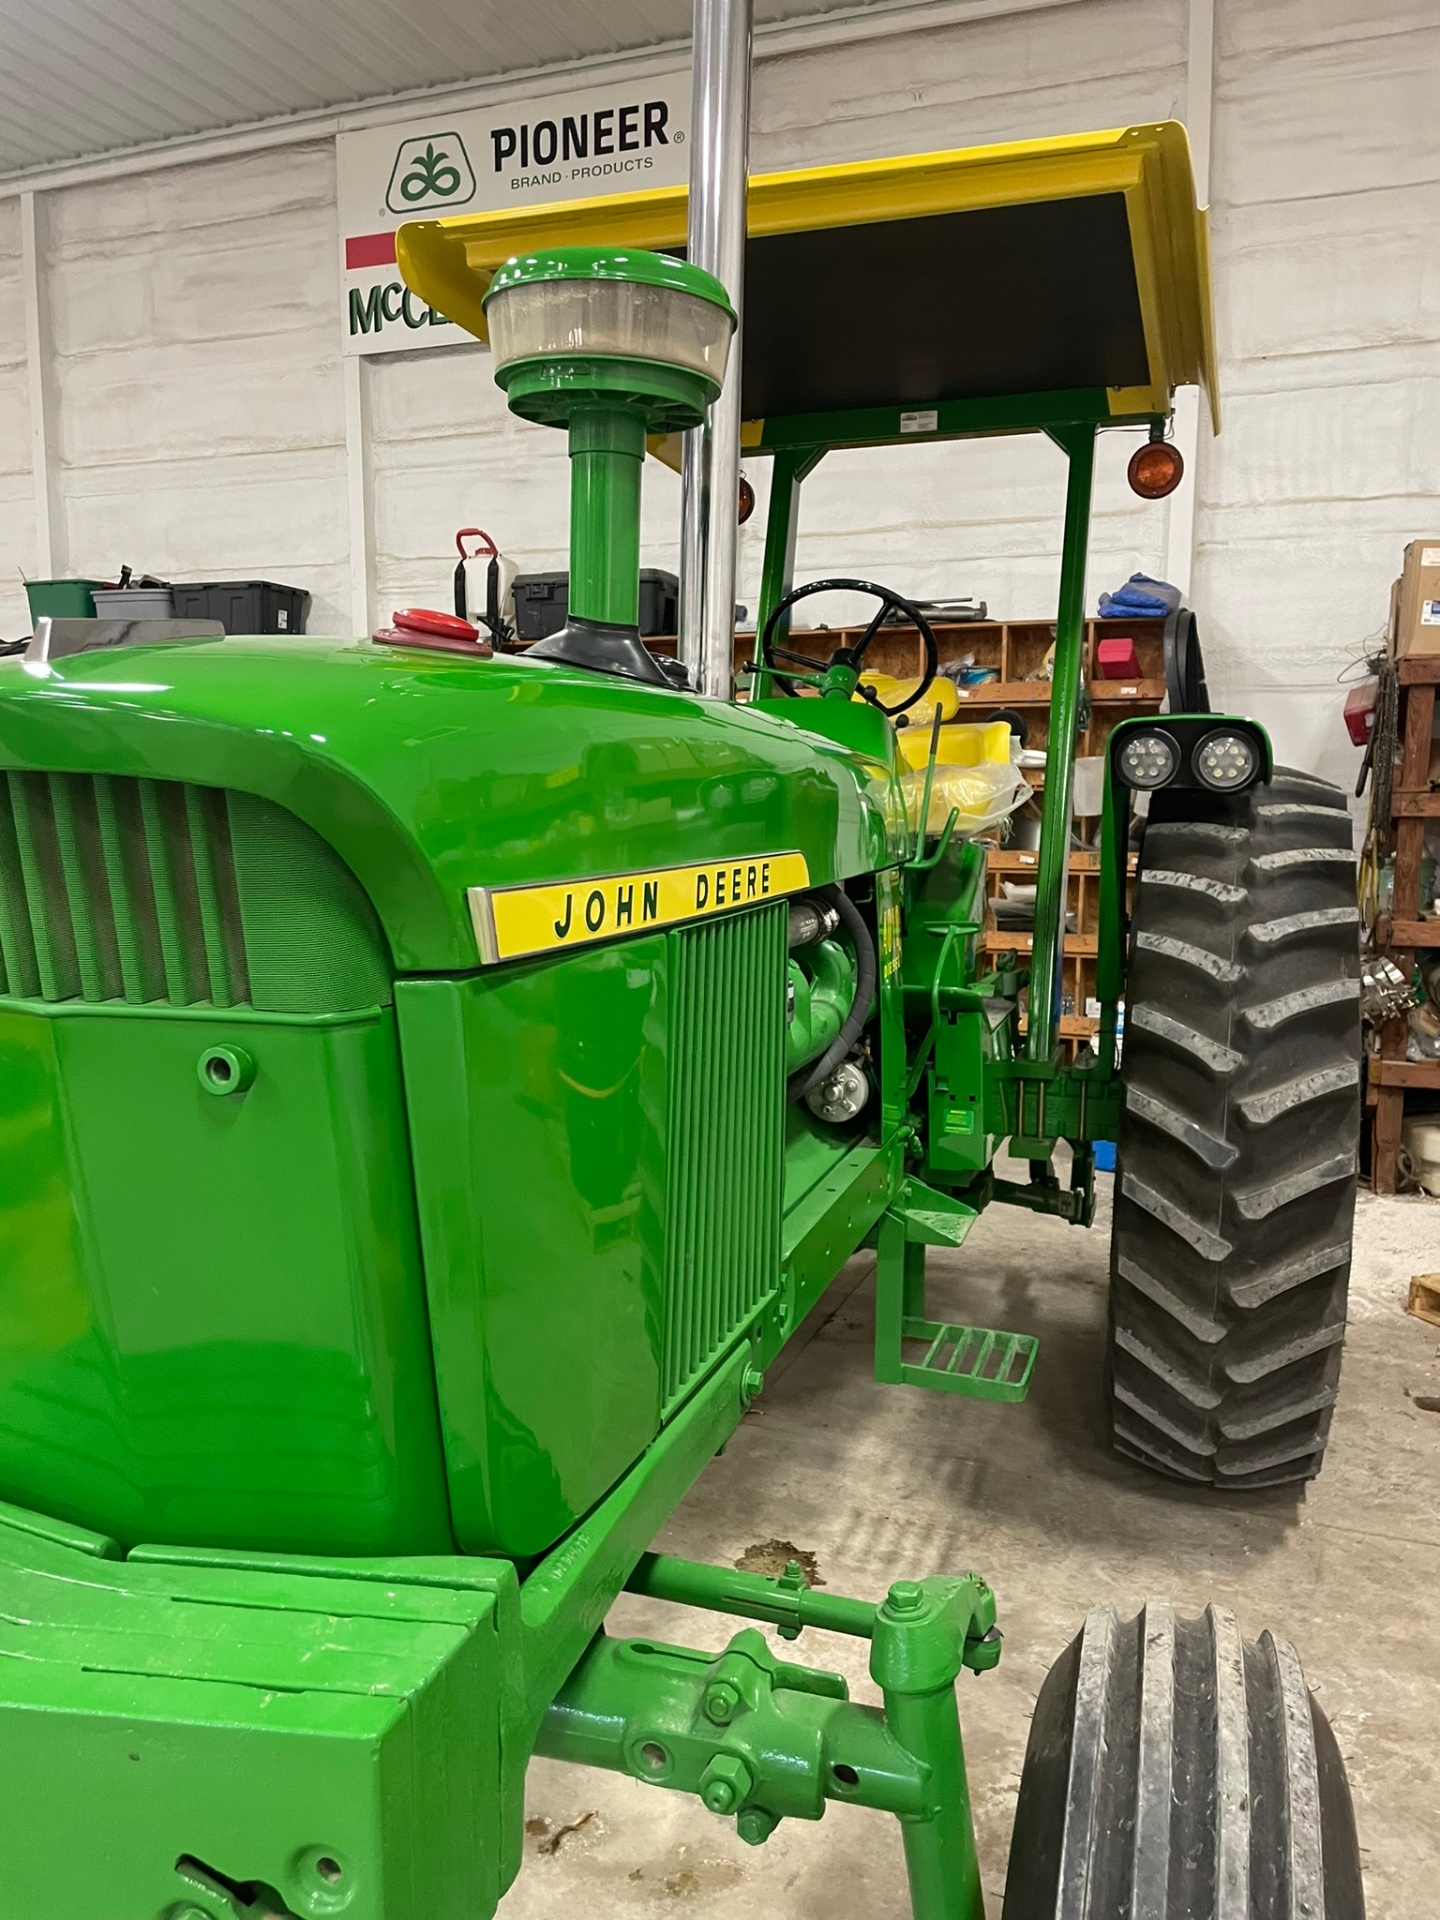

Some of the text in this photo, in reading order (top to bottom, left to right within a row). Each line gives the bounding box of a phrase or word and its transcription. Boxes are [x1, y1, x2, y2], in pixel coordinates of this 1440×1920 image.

[490, 101, 669, 172] PIONEER
[511, 157, 653, 189] BRAND PRODUCTS
[554, 863, 770, 939] JOHN DEERE
